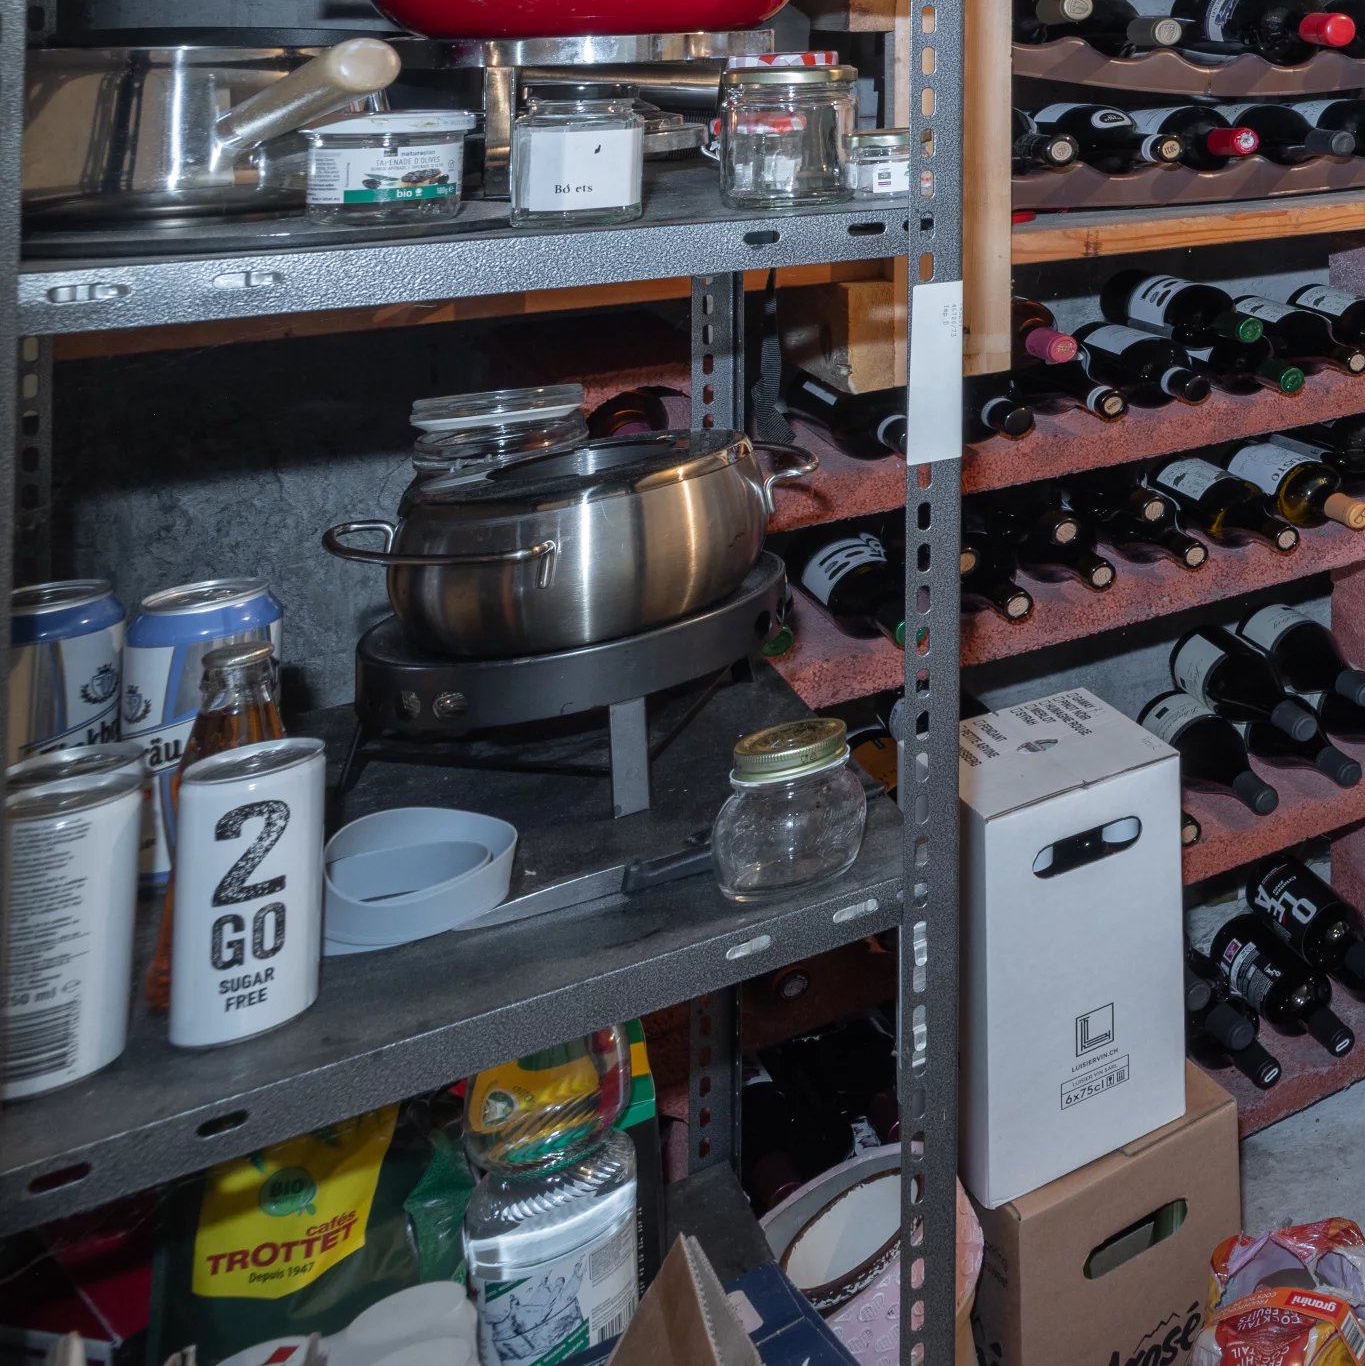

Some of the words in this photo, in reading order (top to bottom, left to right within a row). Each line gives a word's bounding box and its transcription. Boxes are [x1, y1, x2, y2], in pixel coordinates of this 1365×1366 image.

[396, 188, 412, 198] bio
[212, 800, 291, 908] 2
[210, 901, 287, 971] GO
[218, 967, 276, 994] SUGAR
[225, 987, 269, 1013] FREE
[1071, 1047, 1119, 1073] LUISIERVIN.CH
[1065, 1079, 1104, 1105] 6x75cl
[305, 1210, 357, 1236] cafés
[206, 1218, 358, 1276] TROTTET
[248, 1266, 285, 1284] Depuis
[287, 1261, 315, 1279] 1947
[1291, 1295, 1337, 1312] granini
